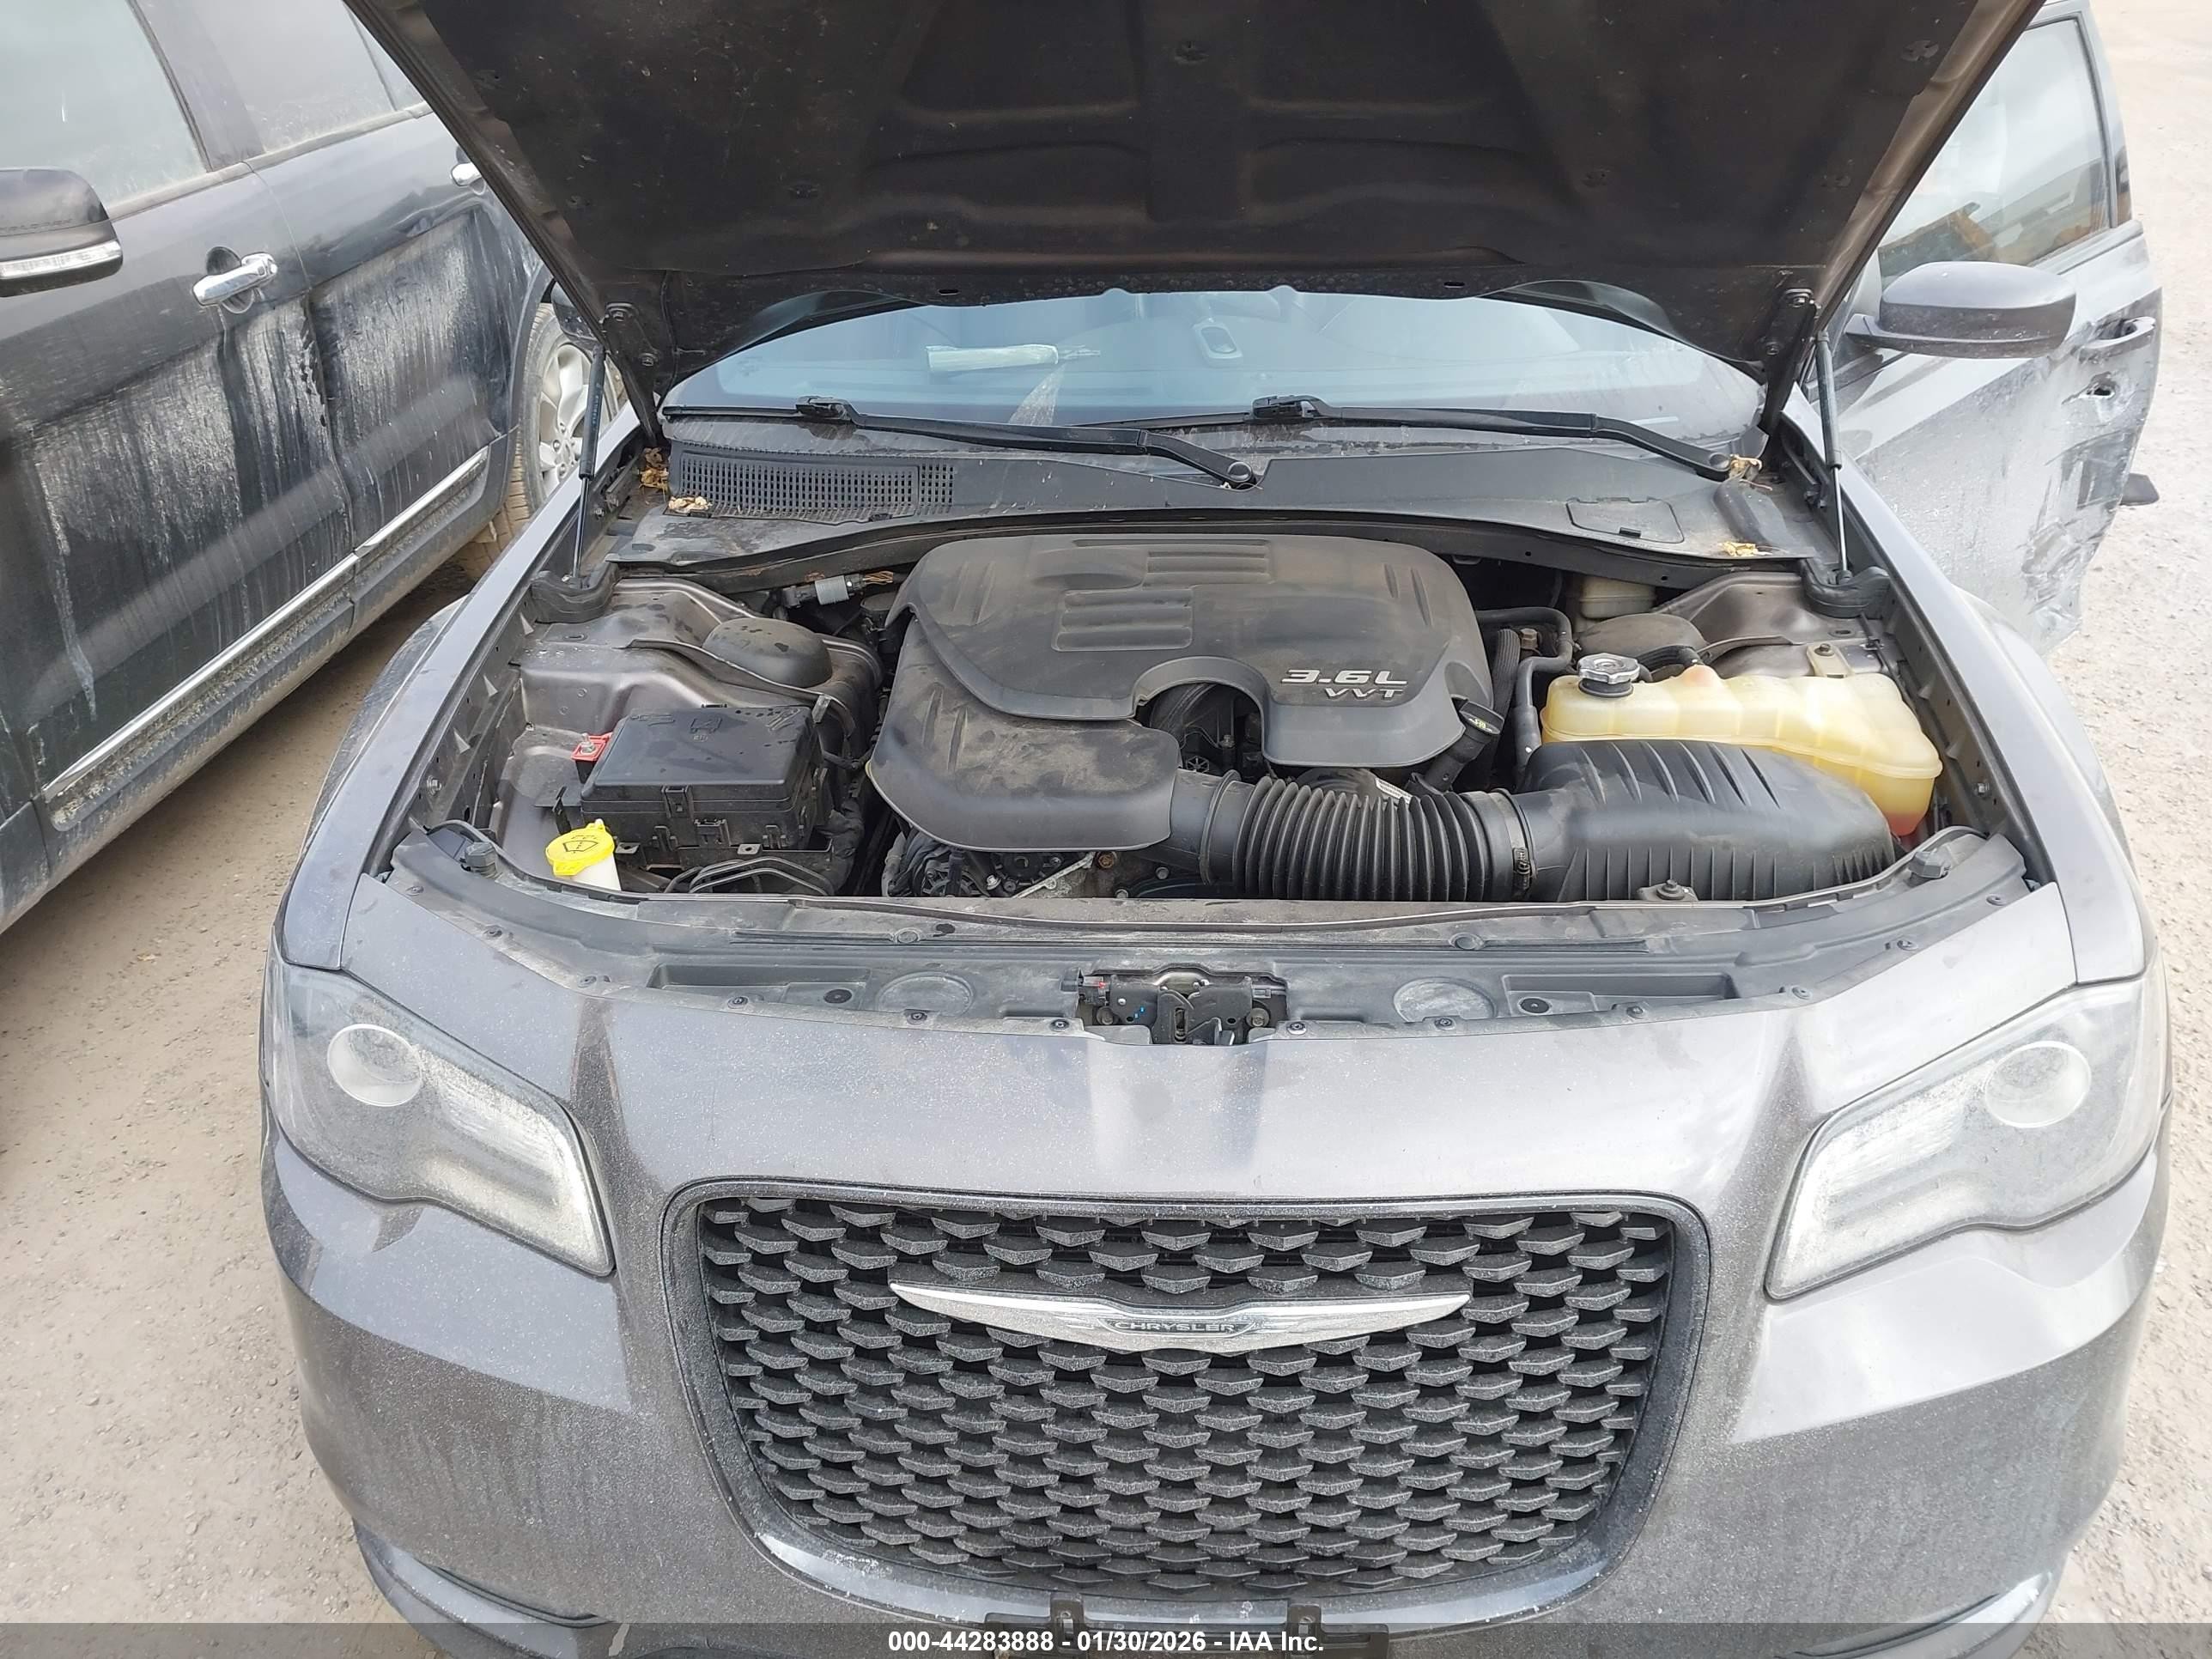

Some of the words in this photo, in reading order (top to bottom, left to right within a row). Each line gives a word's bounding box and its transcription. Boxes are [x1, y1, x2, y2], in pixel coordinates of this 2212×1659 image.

[1281, 669, 1408, 684] 3.6L
[1325, 688, 1404, 699] VVT
[1115, 1322, 1236, 1332] CHRYSLER
